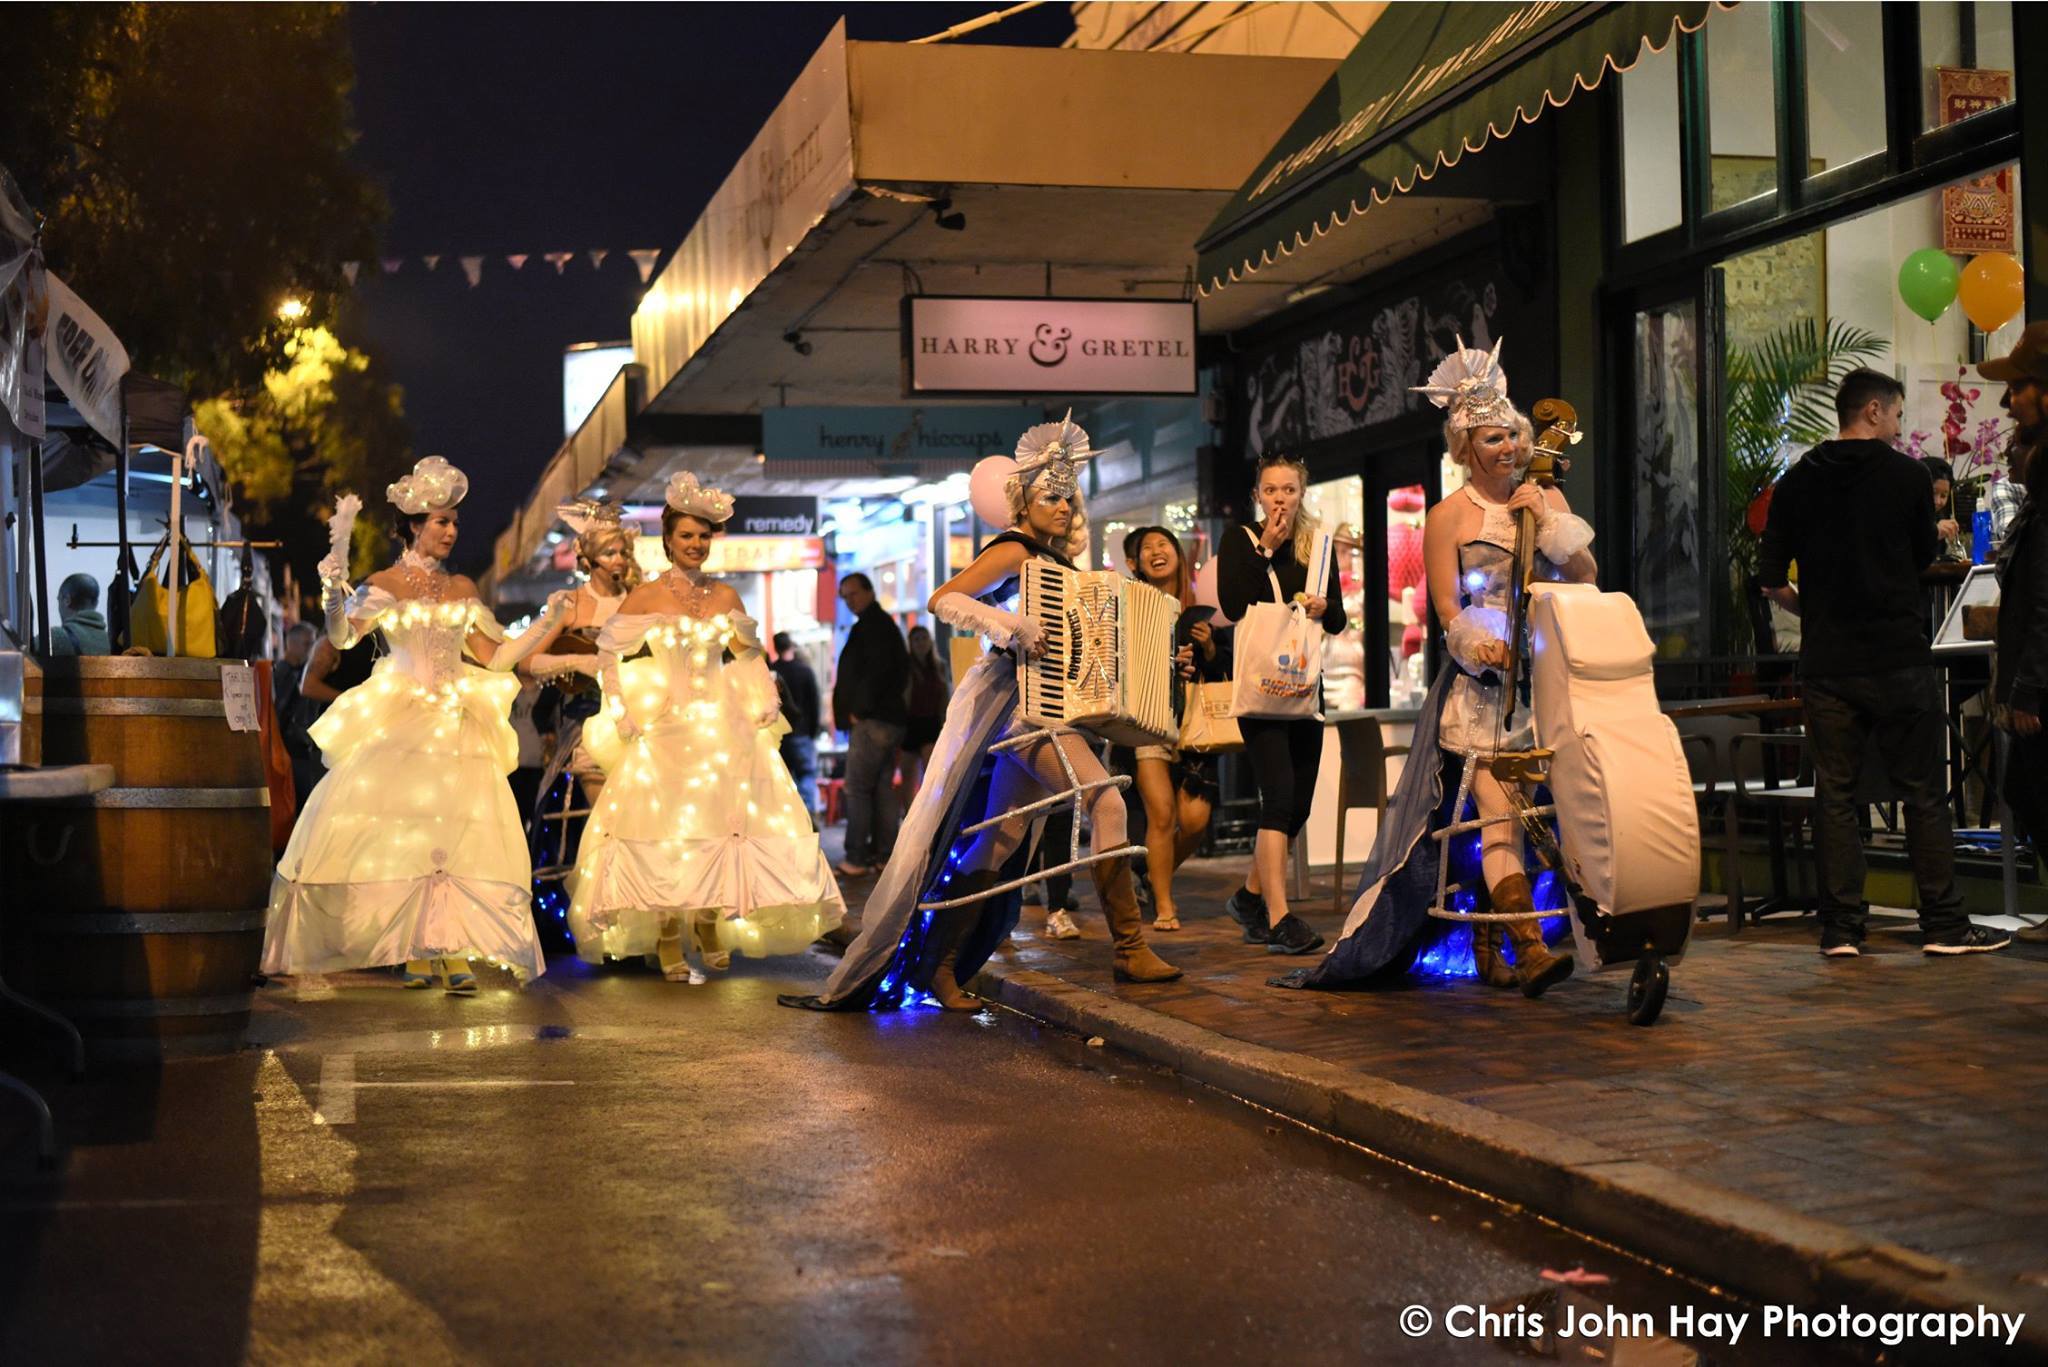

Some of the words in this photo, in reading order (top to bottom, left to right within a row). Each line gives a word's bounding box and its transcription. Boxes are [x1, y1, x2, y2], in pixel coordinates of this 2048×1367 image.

[920, 337, 1020, 355] HARRY
[1029, 323, 1072, 367] &
[1082, 339, 1189, 358] GRETEL
[820, 425, 885, 454] henry
[918, 428, 1004, 455] hiccups
[745, 514, 814, 533] remedy
